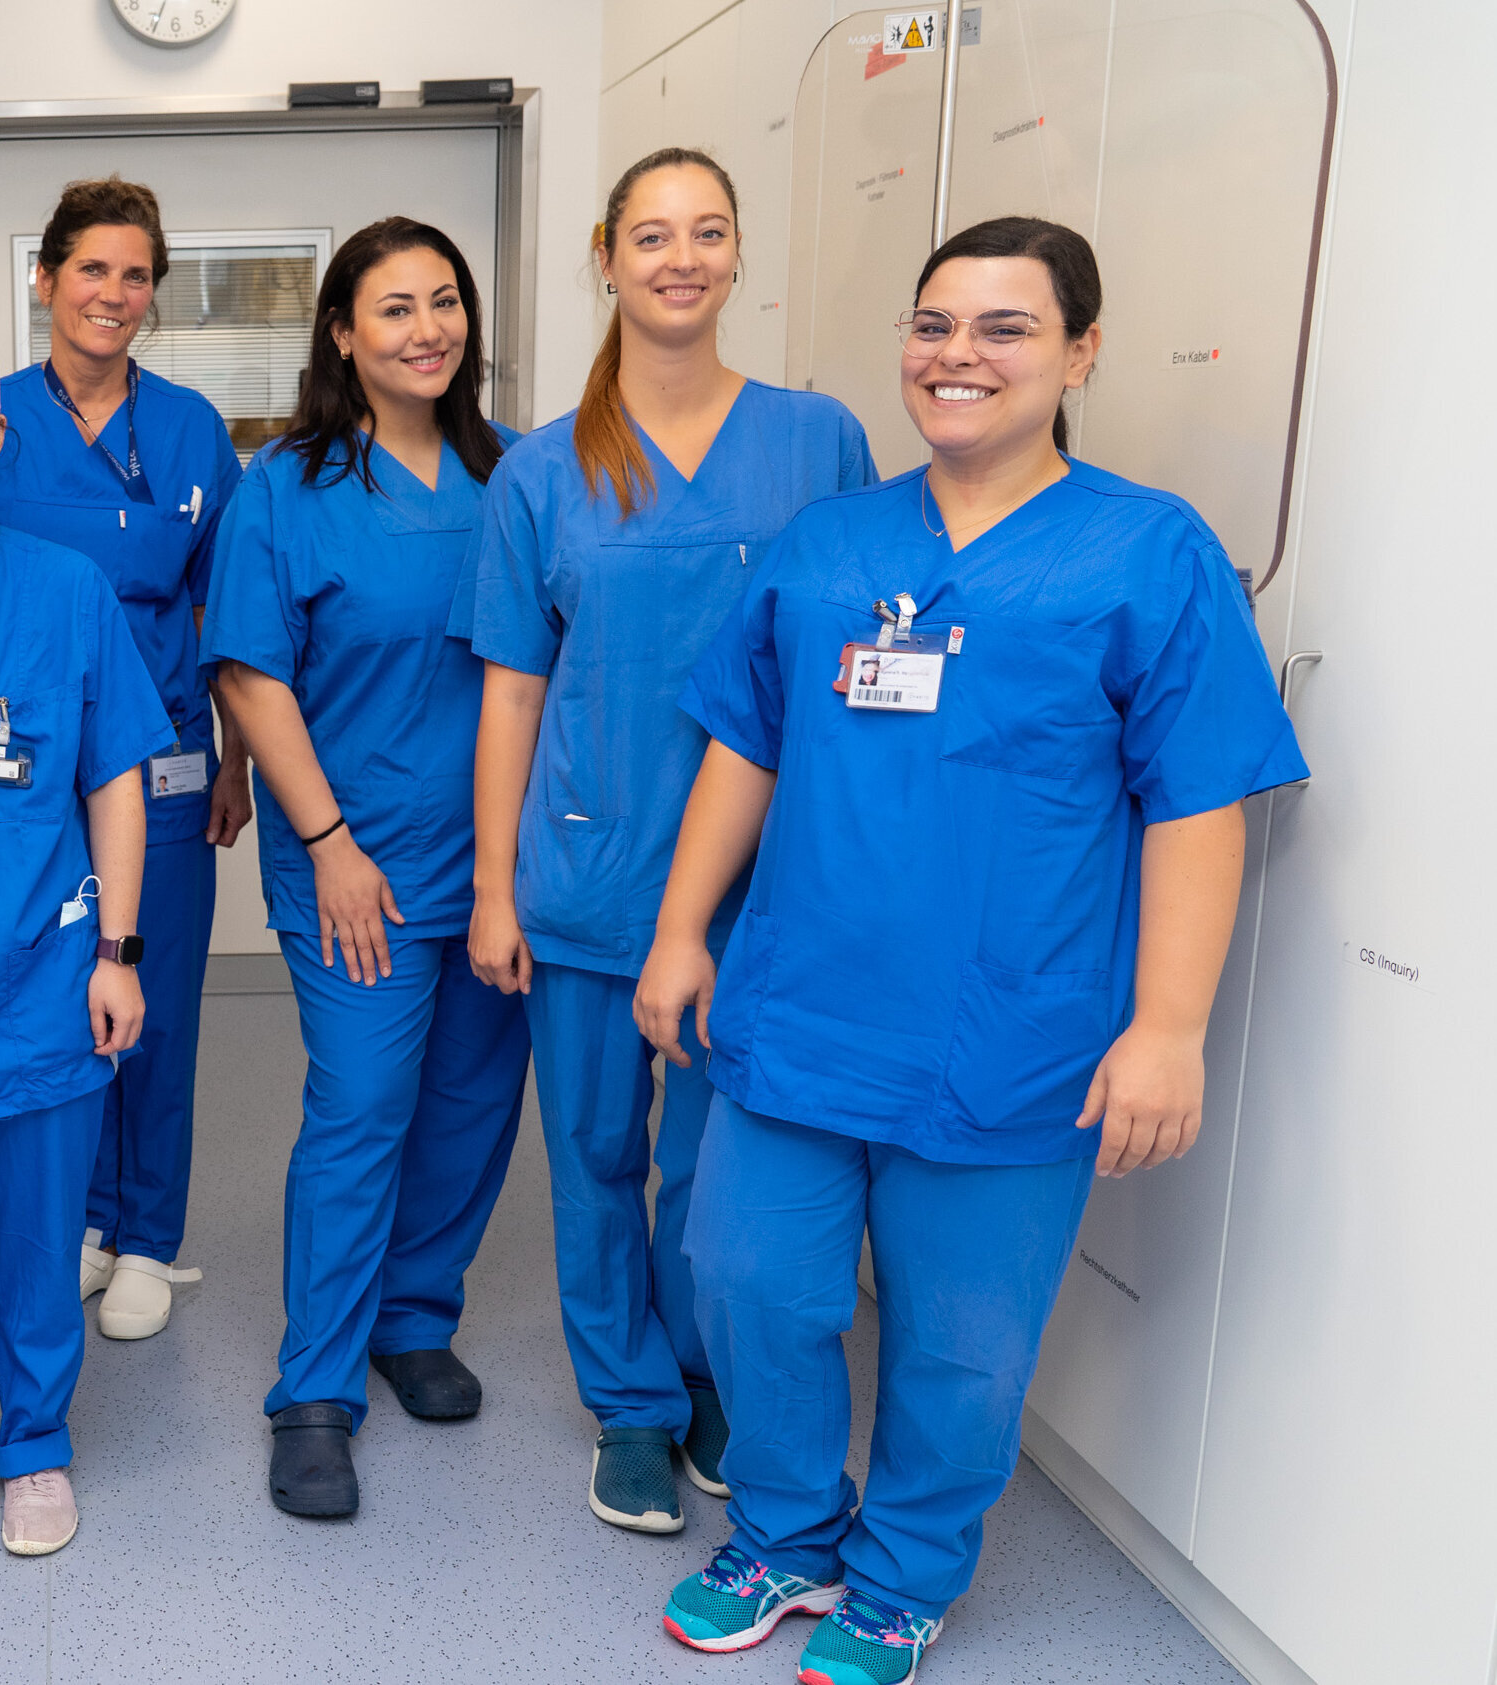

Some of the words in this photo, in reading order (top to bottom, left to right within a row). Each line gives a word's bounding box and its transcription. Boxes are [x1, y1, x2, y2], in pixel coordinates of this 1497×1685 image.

[170, 17, 181, 33] 6
[194, 10, 204, 26] 5
[1188, 349, 1210, 363] Kabel
[1359, 948, 1376, 965] CS
[1377, 953, 1420, 983] (Inquiry)
